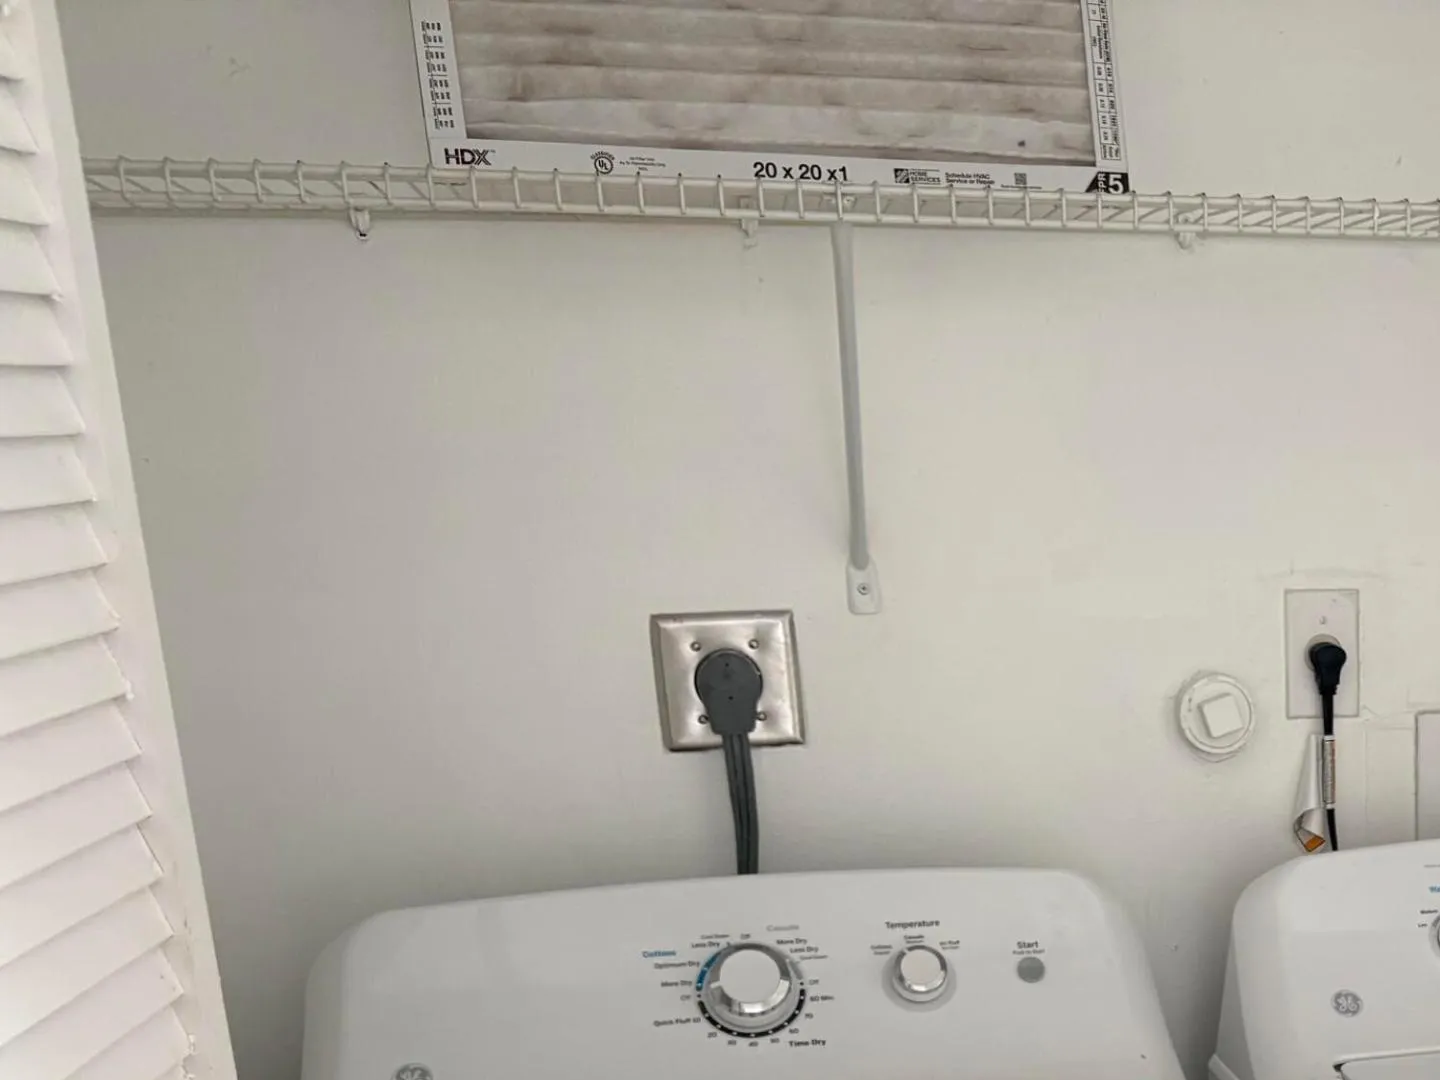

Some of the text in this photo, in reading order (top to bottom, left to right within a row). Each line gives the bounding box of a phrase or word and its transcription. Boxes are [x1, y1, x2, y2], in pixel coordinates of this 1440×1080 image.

[444, 148, 491, 165] HDX
[753, 161, 848, 181] 20 x 20 x1
[1107, 174, 1124, 194] 5
[885, 919, 940, 930] Temperature
[1016, 941, 1039, 949] Start
[811, 1038, 826, 1047] Dry
